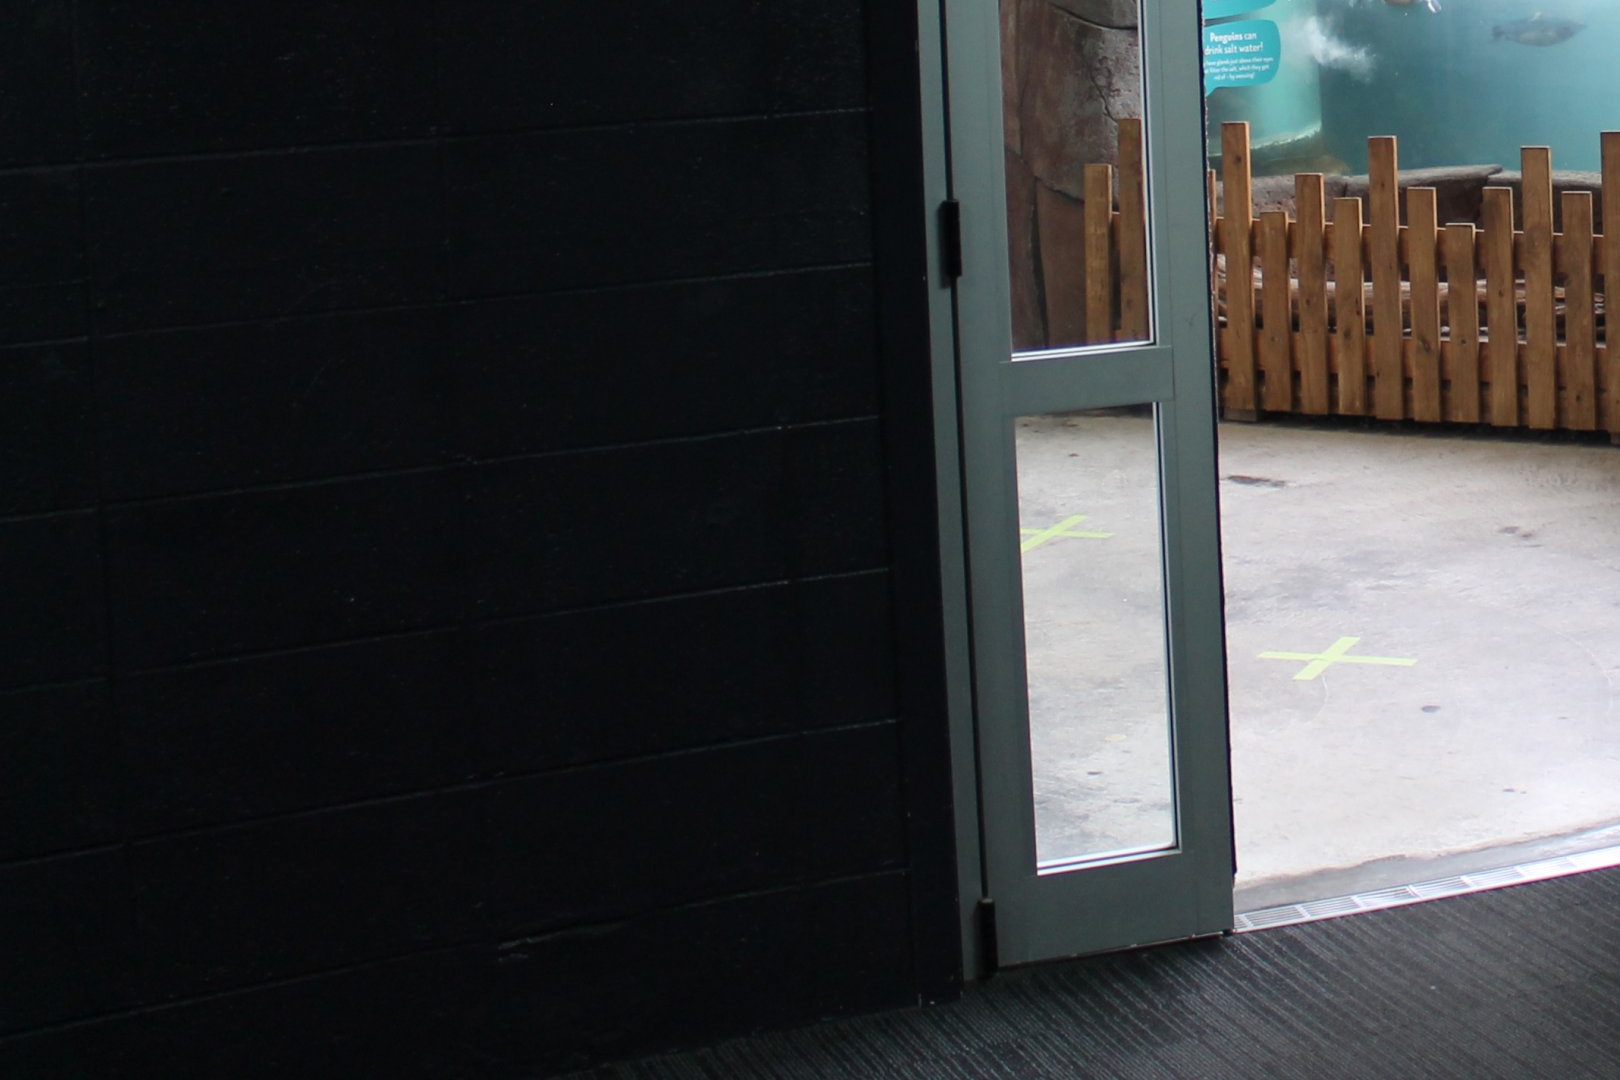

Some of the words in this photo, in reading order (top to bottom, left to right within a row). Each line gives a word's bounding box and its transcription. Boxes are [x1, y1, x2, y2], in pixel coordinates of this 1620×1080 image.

[1210, 32, 1243, 44] Penguins
[1244, 32, 1257, 40] can
[1204, 44, 1223, 55] drink
[1224, 44, 1237, 54] salt
[1239, 42, 1264, 52] water!
